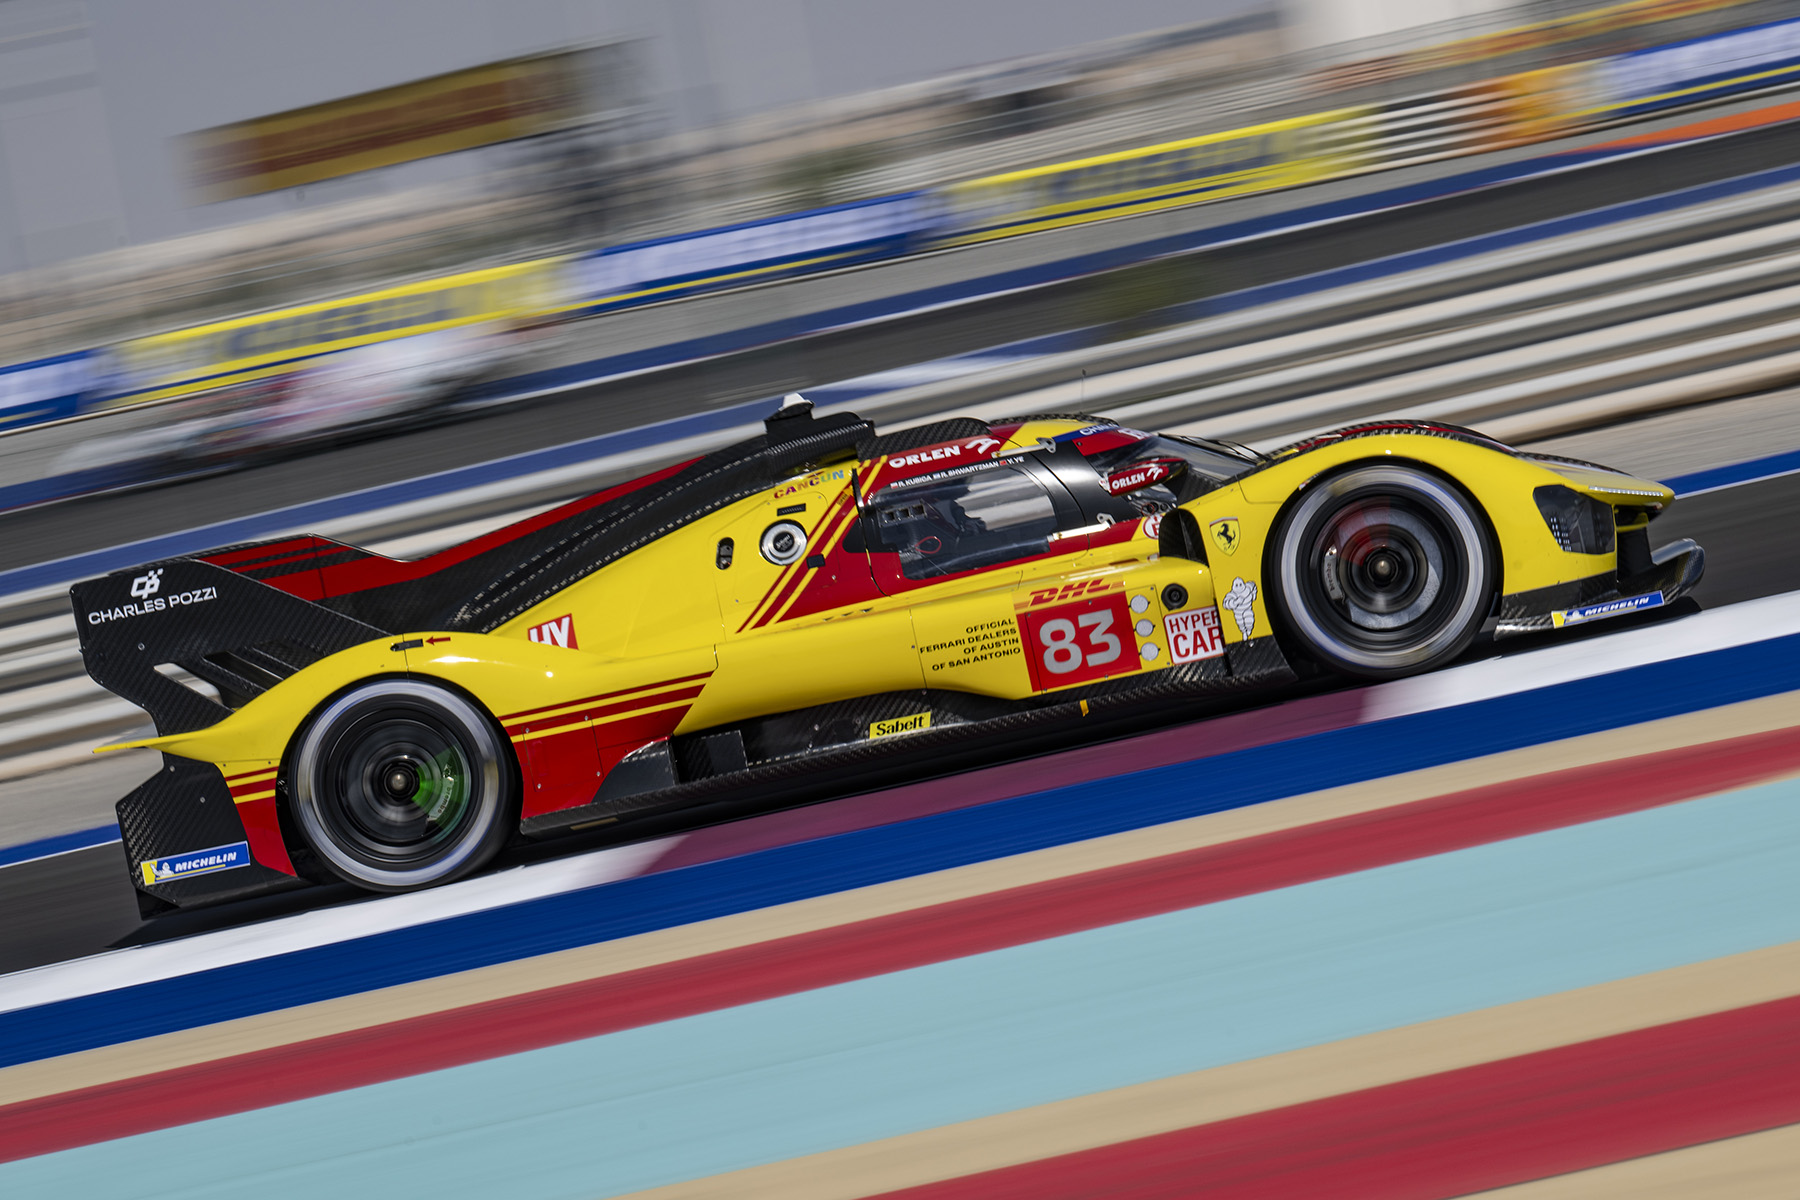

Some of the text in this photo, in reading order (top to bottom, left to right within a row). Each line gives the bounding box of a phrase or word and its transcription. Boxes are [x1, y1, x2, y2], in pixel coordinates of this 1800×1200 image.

[888, 445, 961, 468] ORLEN
[1111, 472, 1146, 490] ORLEN
[1029, 578, 1111, 607] DHL
[88, 586, 218, 625] CHARLES POZZI
[1584, 597, 1650, 616] MICHELIN
[965, 618, 1015, 634] OFFICIAL
[919, 627, 1018, 654] FERRARI DEALERS
[963, 636, 1020, 655] OF AUSTIN
[1039, 608, 1122, 674] 83
[931, 647, 1021, 672] OF SAN ANTONIO
[876, 715, 925, 737] Sabelt
[175, 851, 237, 872] MICHELIN
